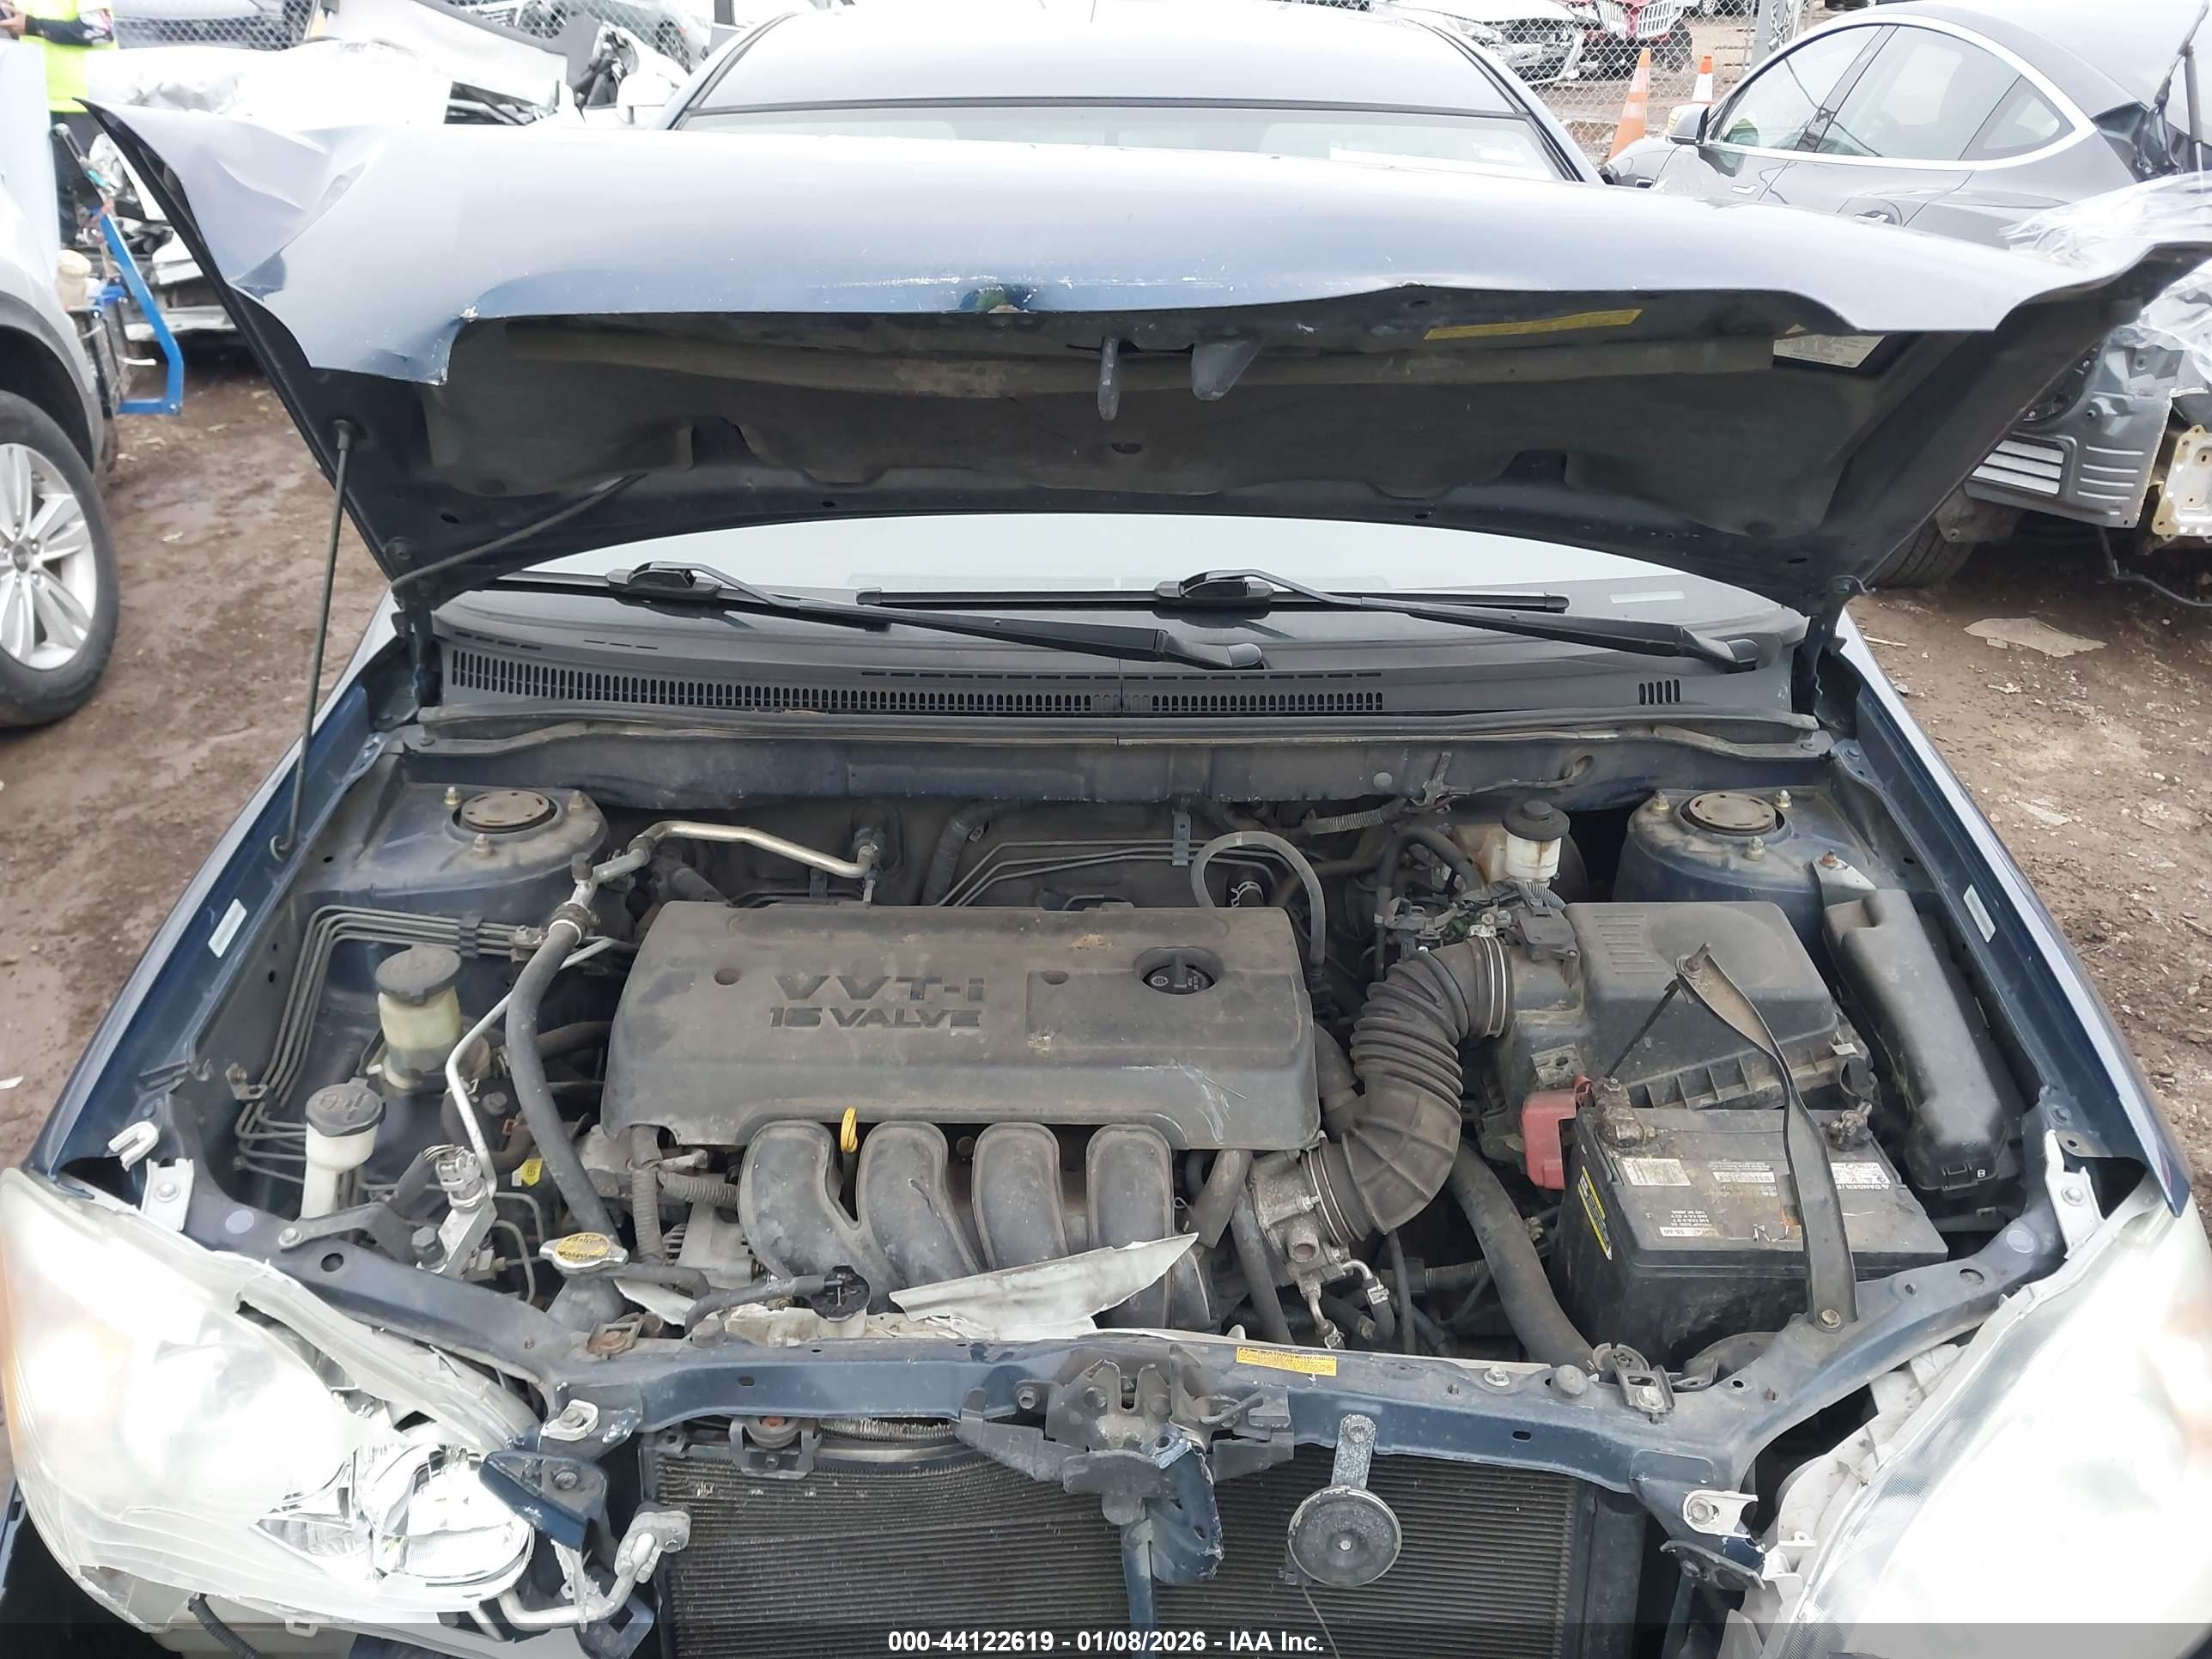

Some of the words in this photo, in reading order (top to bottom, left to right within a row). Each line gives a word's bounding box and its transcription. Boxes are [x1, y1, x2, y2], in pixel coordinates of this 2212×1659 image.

[770, 1007, 823, 1028] 16
[830, 1008, 981, 1029] VALVE
[1977, 1169, 1986, 1178] B
